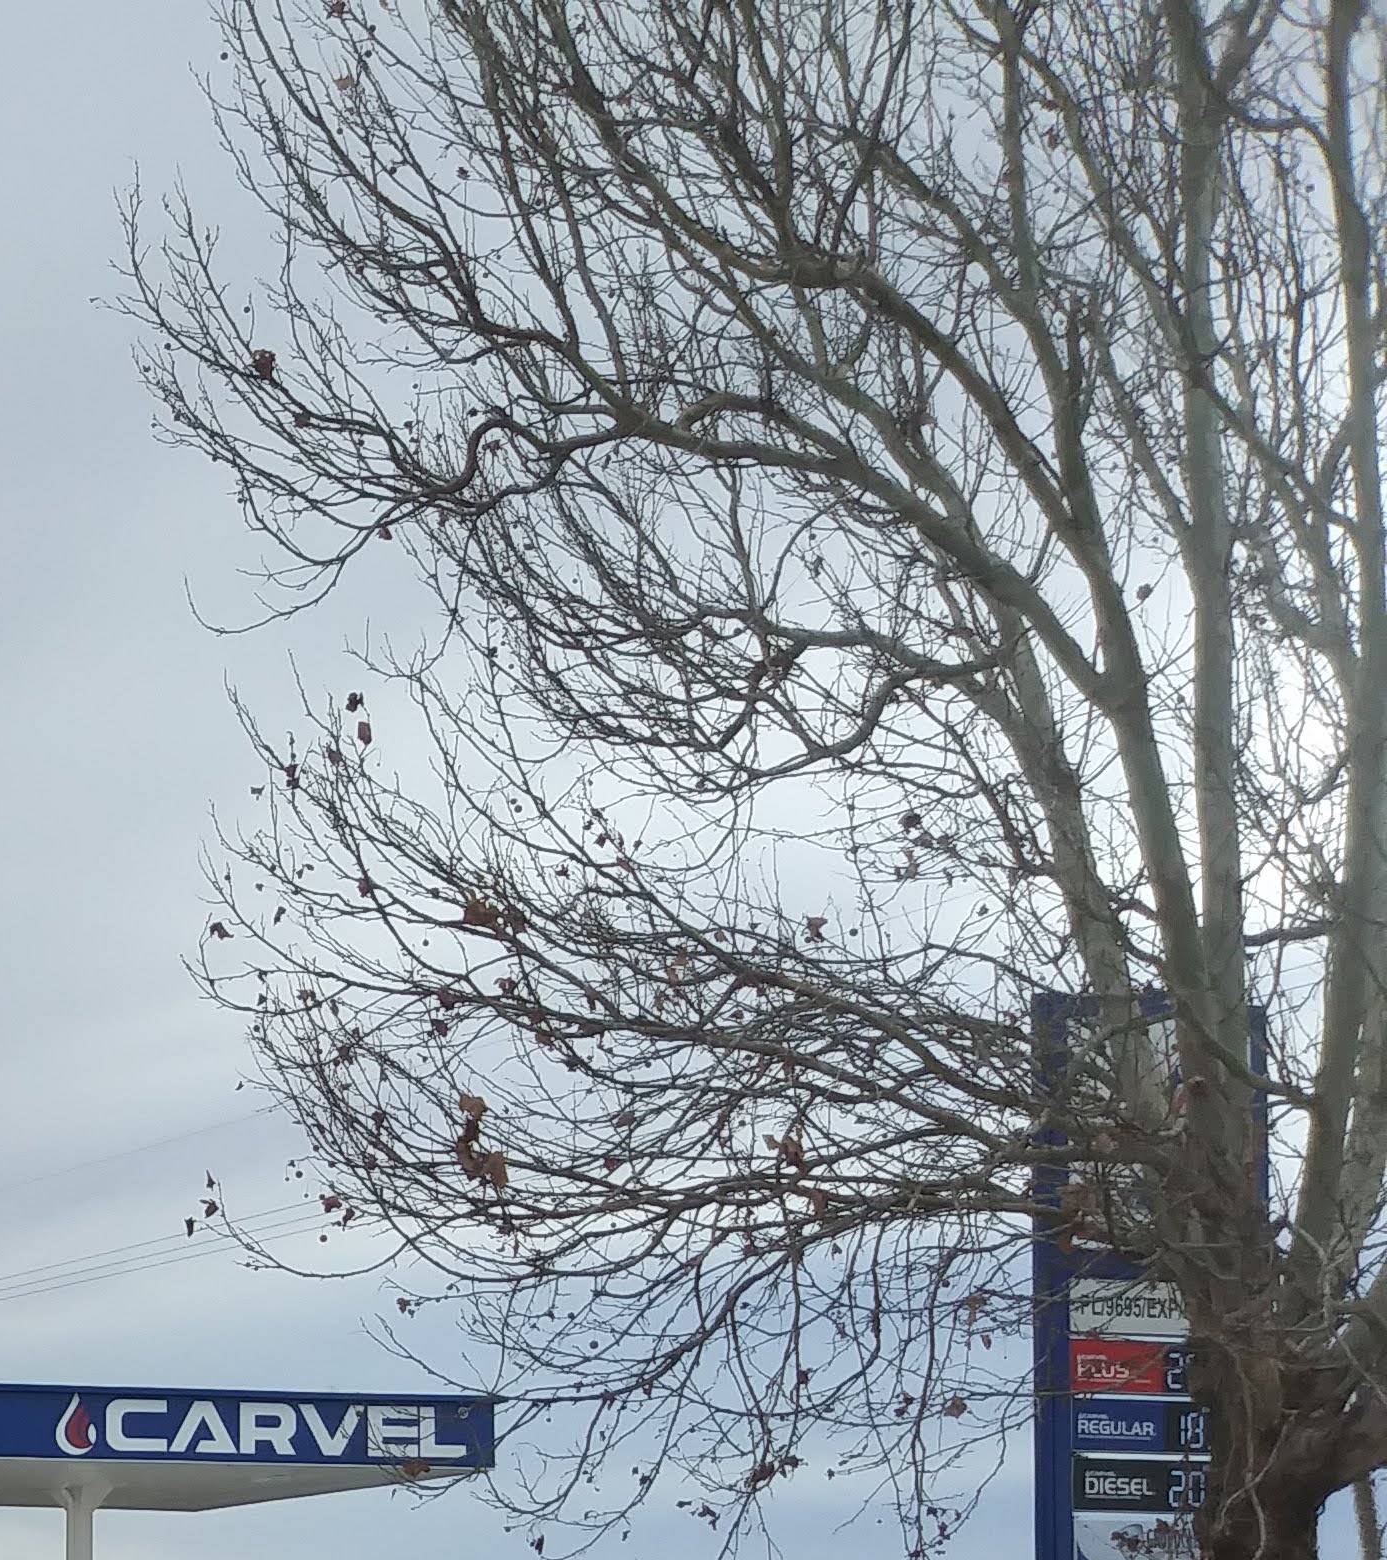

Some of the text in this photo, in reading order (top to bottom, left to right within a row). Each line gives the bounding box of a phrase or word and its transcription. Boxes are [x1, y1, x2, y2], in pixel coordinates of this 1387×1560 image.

[105, 1398, 468, 1458] CARVEL
[1077, 1418, 1156, 1437] REGULAR
[1084, 1470, 1206, 1508] DIESEL 20
